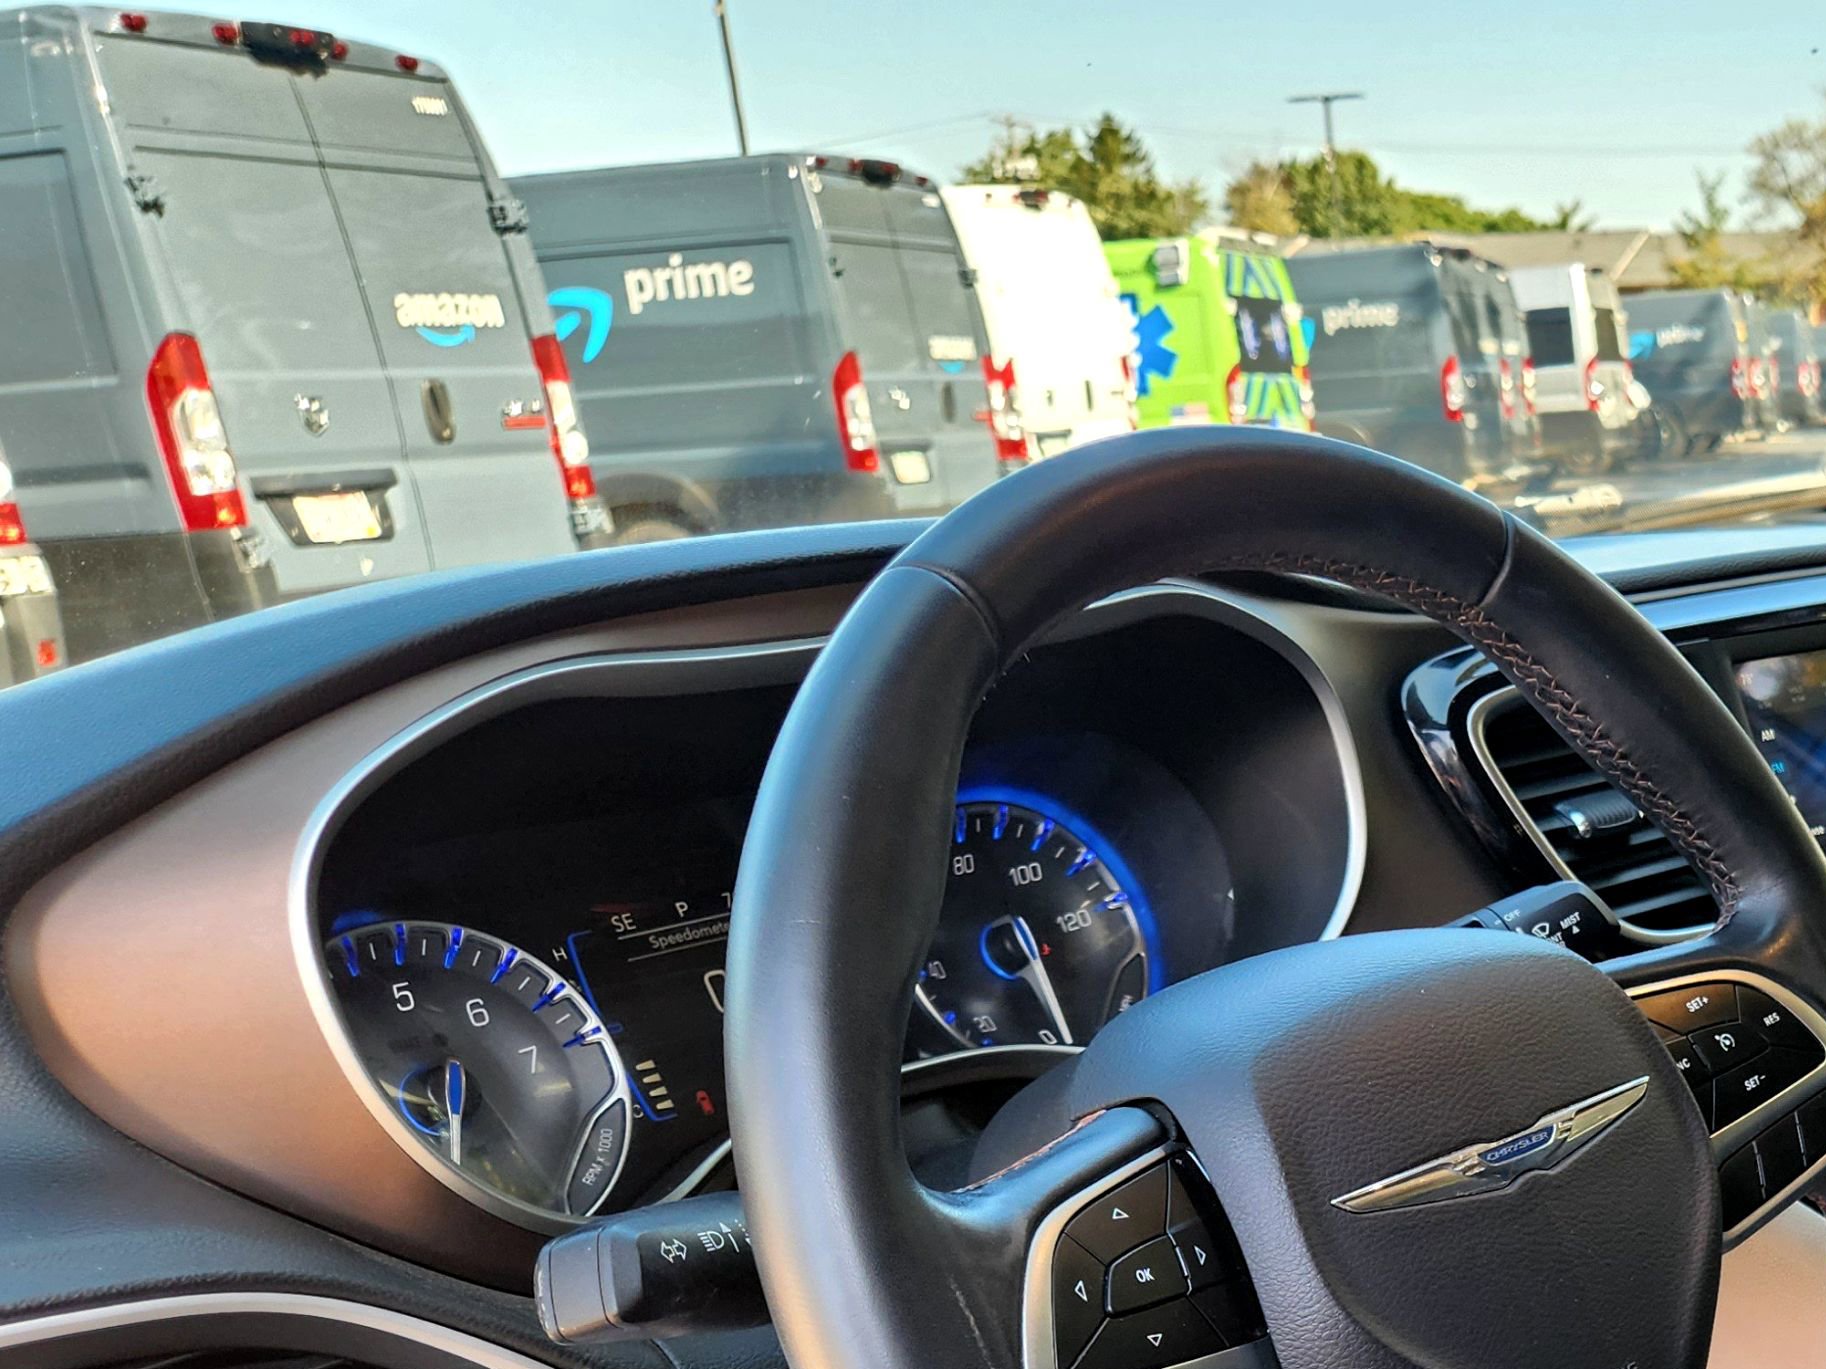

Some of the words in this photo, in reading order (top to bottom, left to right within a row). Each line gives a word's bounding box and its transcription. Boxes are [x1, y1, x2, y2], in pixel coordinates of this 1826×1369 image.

[624, 252, 755, 315] prime
[1761, 729, 1775, 742] AM
[953, 854, 975, 876] 80
[1008, 862, 1043, 886] 100
[610, 913, 637, 933] SE
[675, 901, 689, 918] P
[1056, 909, 1092, 934] 120
[1503, 909, 1520, 922] OFF
[1560, 911, 1581, 930] MIST
[552, 946, 568, 962] H
[392, 981, 416, 1012] 5
[465, 998, 490, 1027] 6
[1763, 1012, 1781, 1027] RES
[1038, 1029, 1059, 1045] 0
[518, 1046, 537, 1074] 7
[581, 1162, 604, 1186] RPM
[598, 1128, 613, 1152] 1000
[1487, 1132, 1549, 1161] CHRYSLER
[1136, 1267, 1155, 1284] OK
